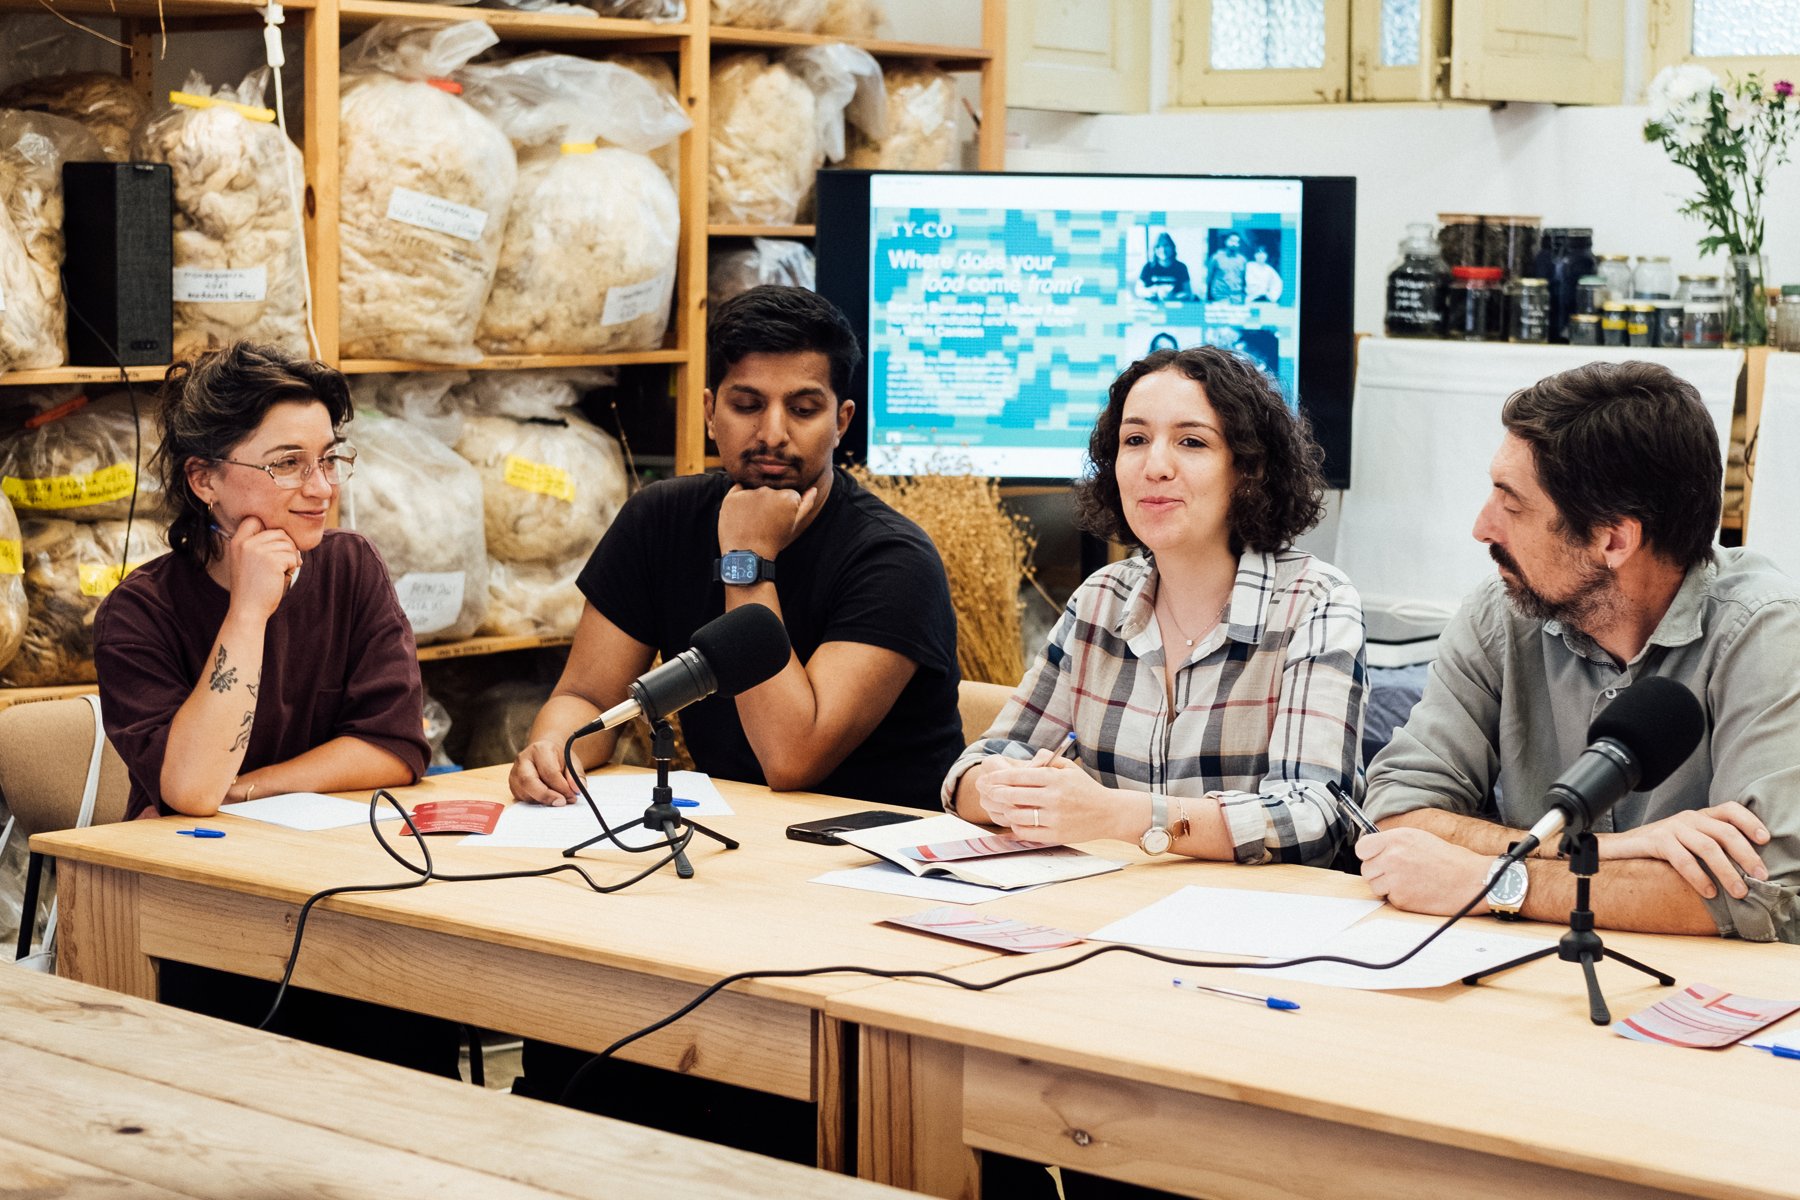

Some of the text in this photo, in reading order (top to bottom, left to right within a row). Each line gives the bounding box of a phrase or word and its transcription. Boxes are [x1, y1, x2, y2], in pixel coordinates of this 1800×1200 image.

[889, 221, 953, 238] TY-CO
[887, 248, 1056, 276] Where does your
[921, 272, 1085, 295] food come from?
